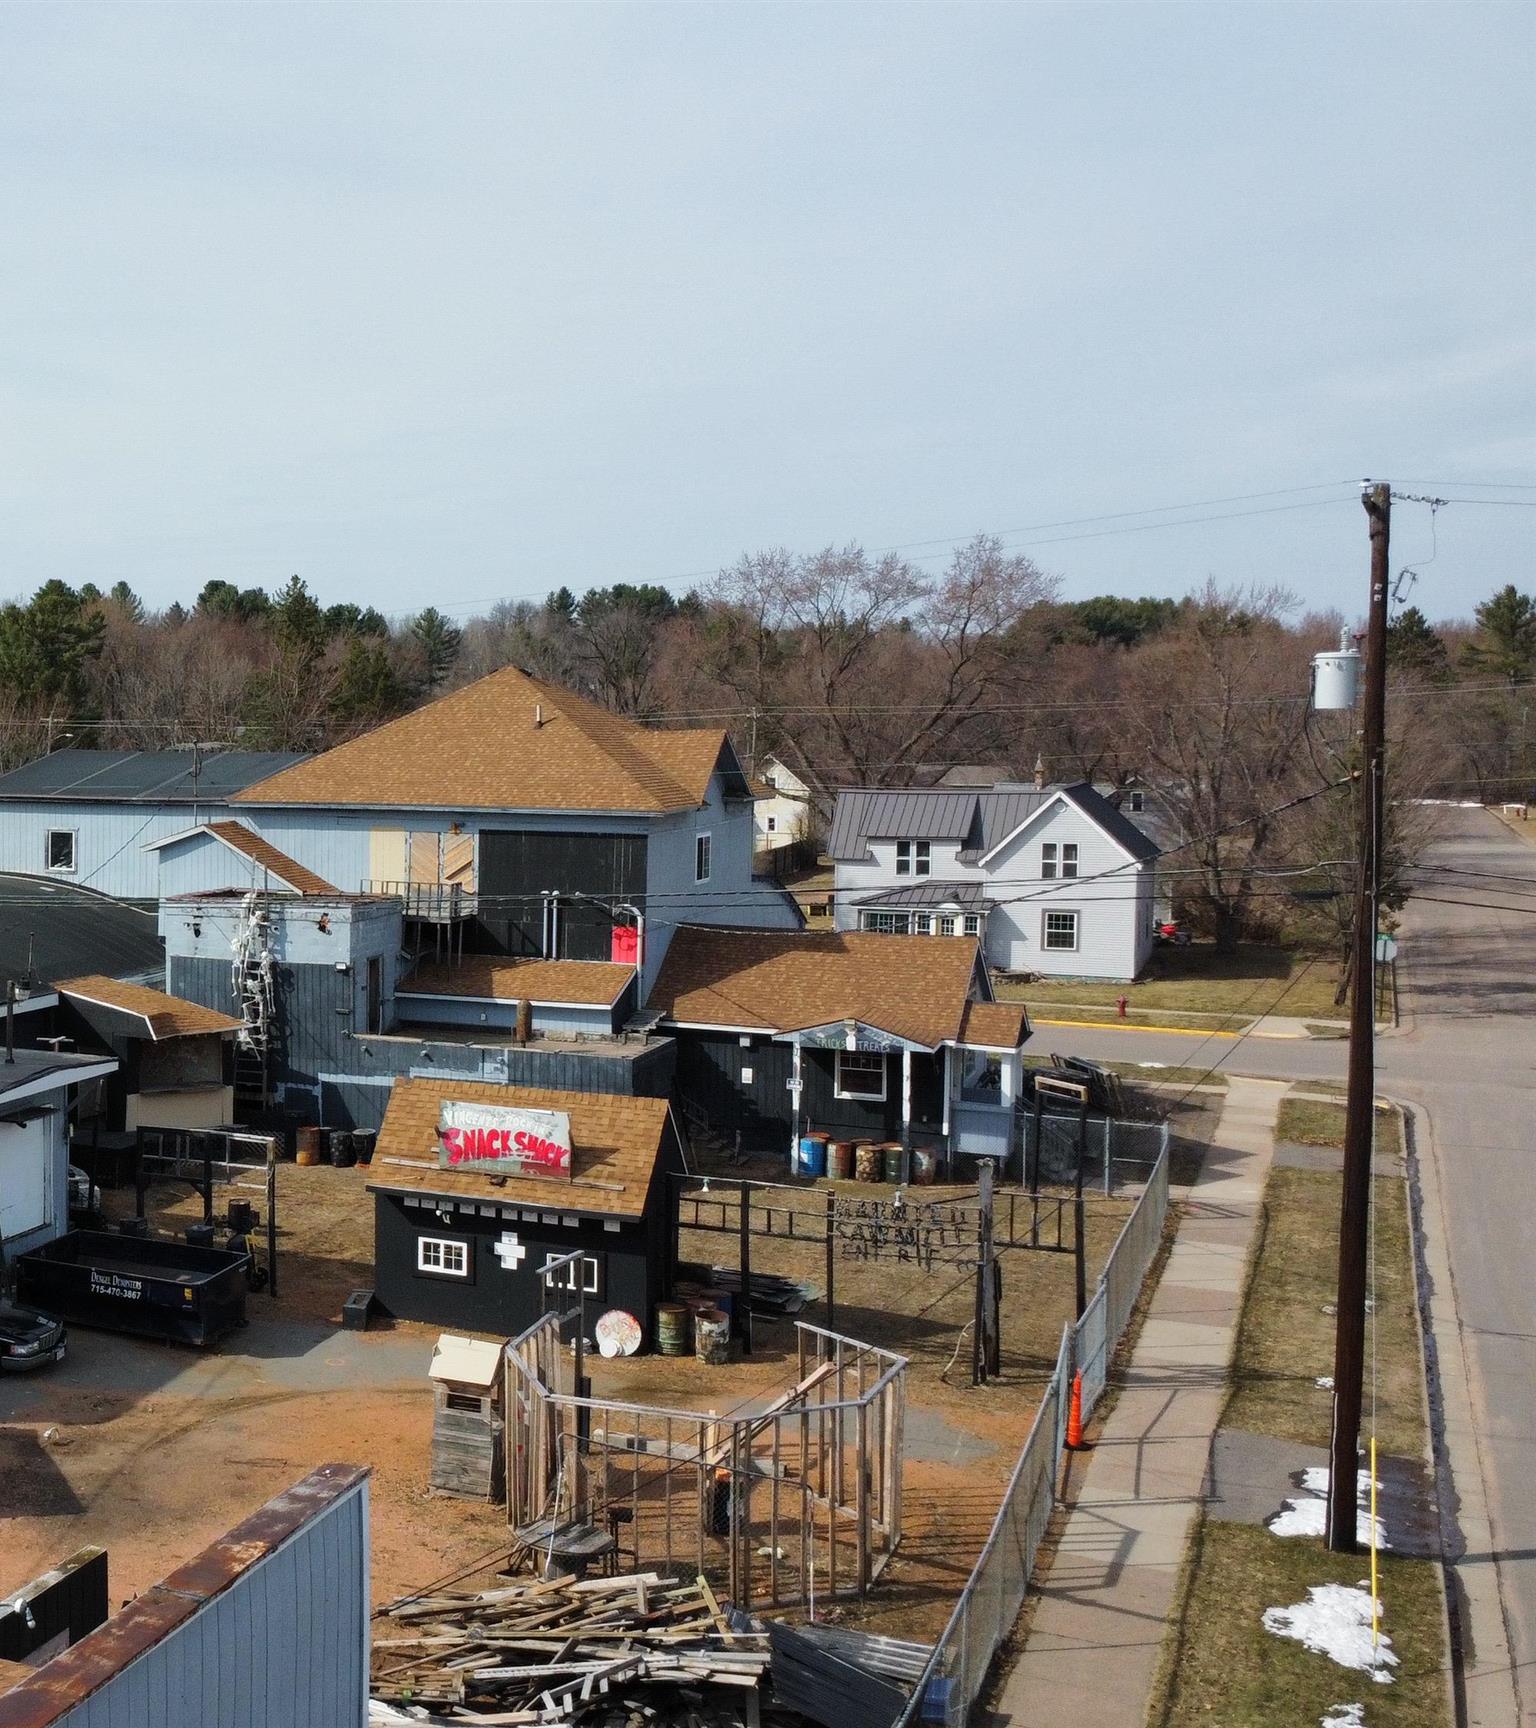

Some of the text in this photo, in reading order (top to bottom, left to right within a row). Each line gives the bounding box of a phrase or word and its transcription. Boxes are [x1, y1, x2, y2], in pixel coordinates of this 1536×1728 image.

[858, 1040, 891, 1053] TREATS
[442, 1127, 569, 1168] SNACK SHACK
